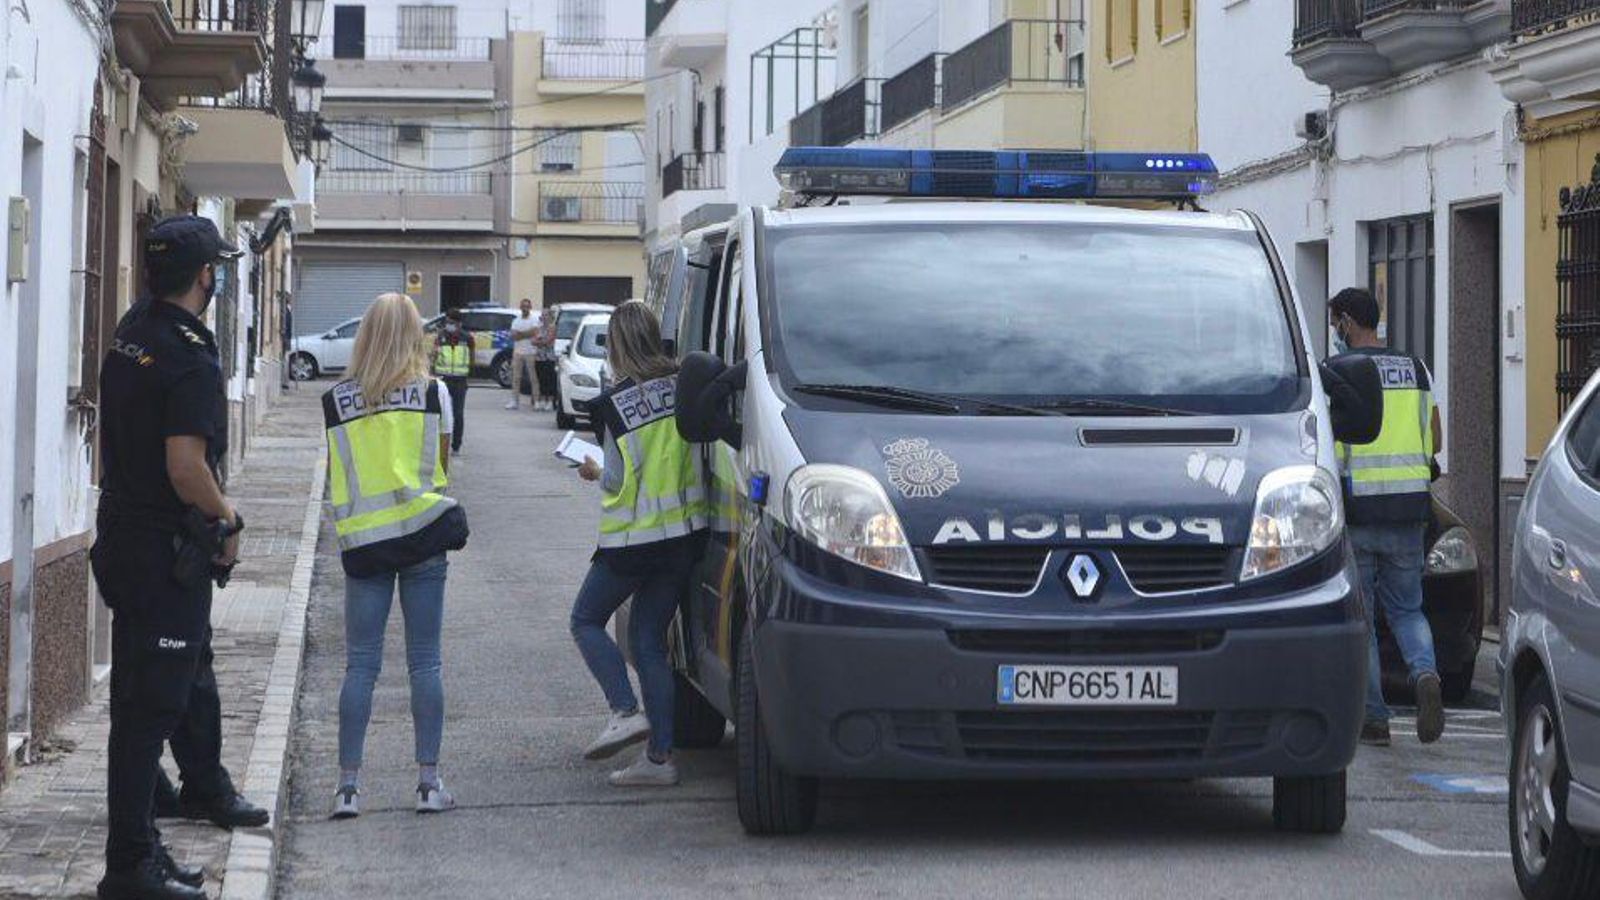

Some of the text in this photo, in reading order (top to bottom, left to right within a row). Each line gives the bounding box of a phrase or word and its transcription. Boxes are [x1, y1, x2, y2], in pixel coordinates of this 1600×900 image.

[1381, 368, 1415, 385] ICIA
[338, 386, 422, 414] POCIA
[623, 392, 676, 425] POLIC
[1014, 670, 1172, 699] CNP6651AL
